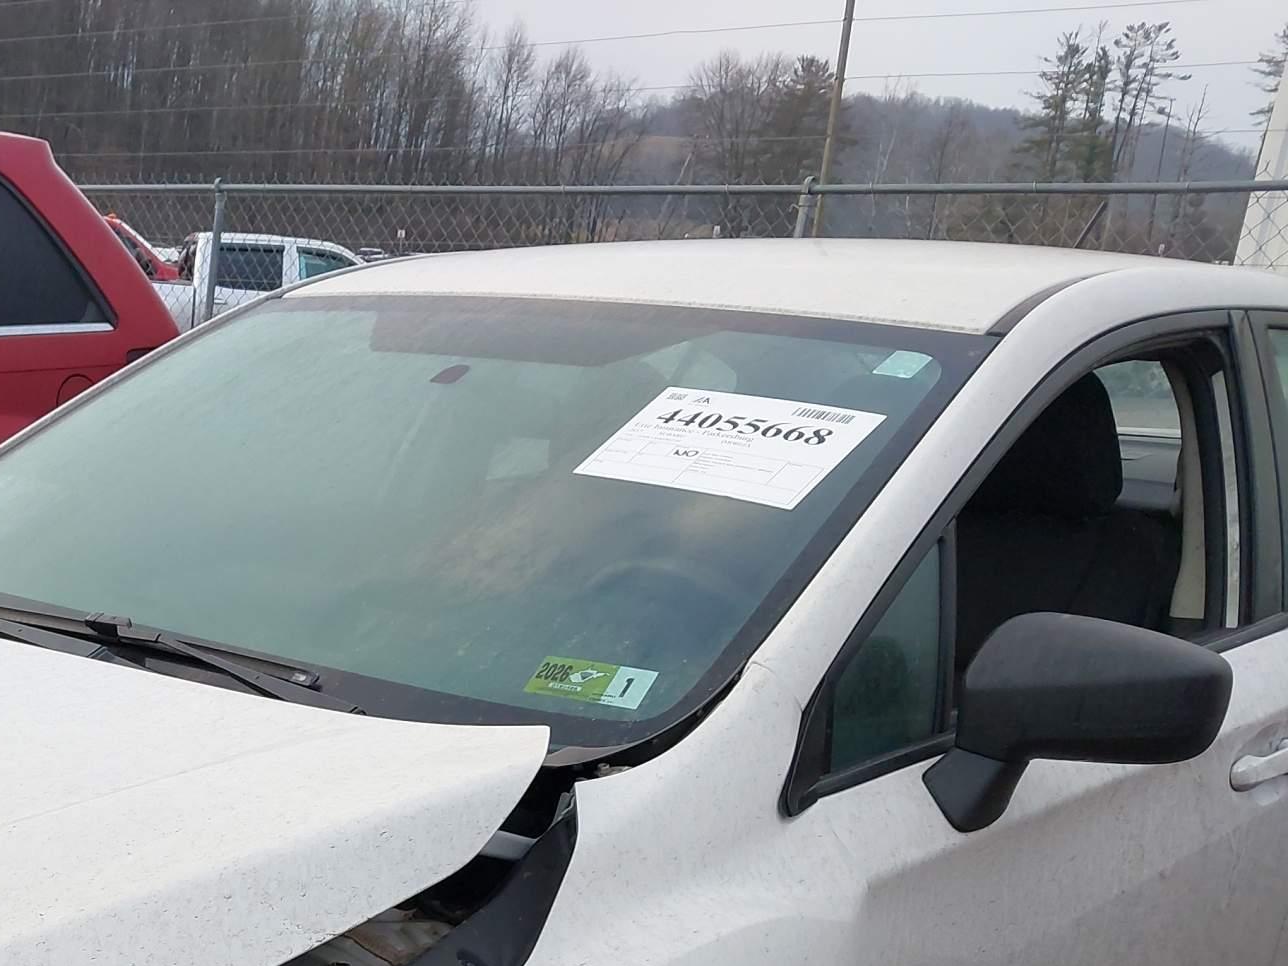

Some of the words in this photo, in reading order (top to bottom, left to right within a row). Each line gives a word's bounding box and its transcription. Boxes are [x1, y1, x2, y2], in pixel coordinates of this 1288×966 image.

[657, 408, 834, 446] 44055668
[536, 662, 573, 682] 2026
[619, 678, 635, 698] 1
